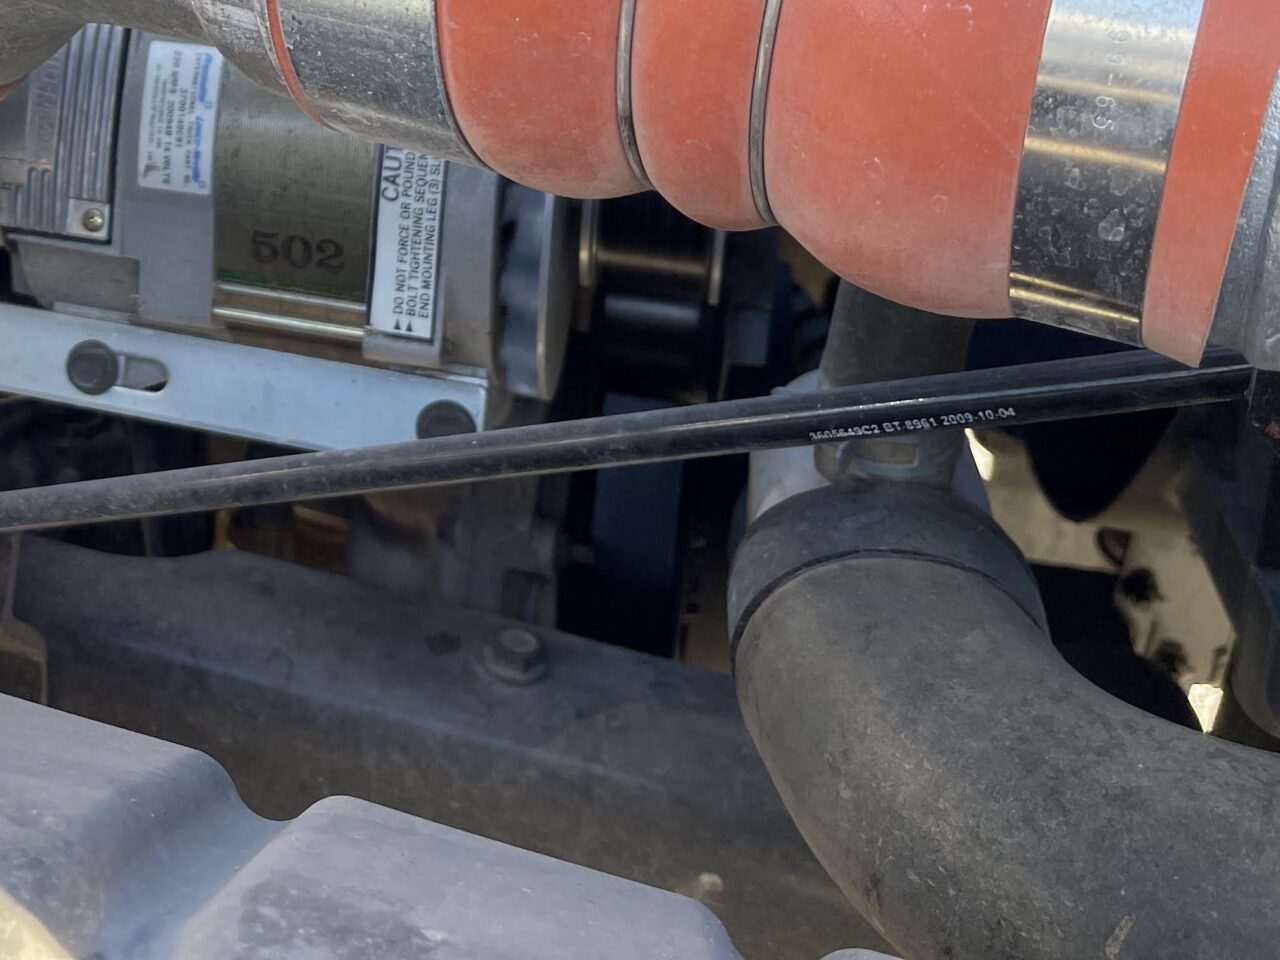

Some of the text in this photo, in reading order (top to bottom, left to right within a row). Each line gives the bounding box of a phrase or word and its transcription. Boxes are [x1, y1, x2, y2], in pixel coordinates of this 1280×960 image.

[428, 179, 441, 195] (3)
[425, 197, 438, 221] LEG
[392, 151, 416, 315] DO NOT FORCE OR POUND
[408, 208, 425, 280] TIGHTENING
[250, 229, 345, 274] 502
[420, 225, 436, 290] MOUNTING
[405, 284, 418, 317] BOLT
[418, 292, 431, 319] END
[940, 406, 1017, 426] 2009-10-04
